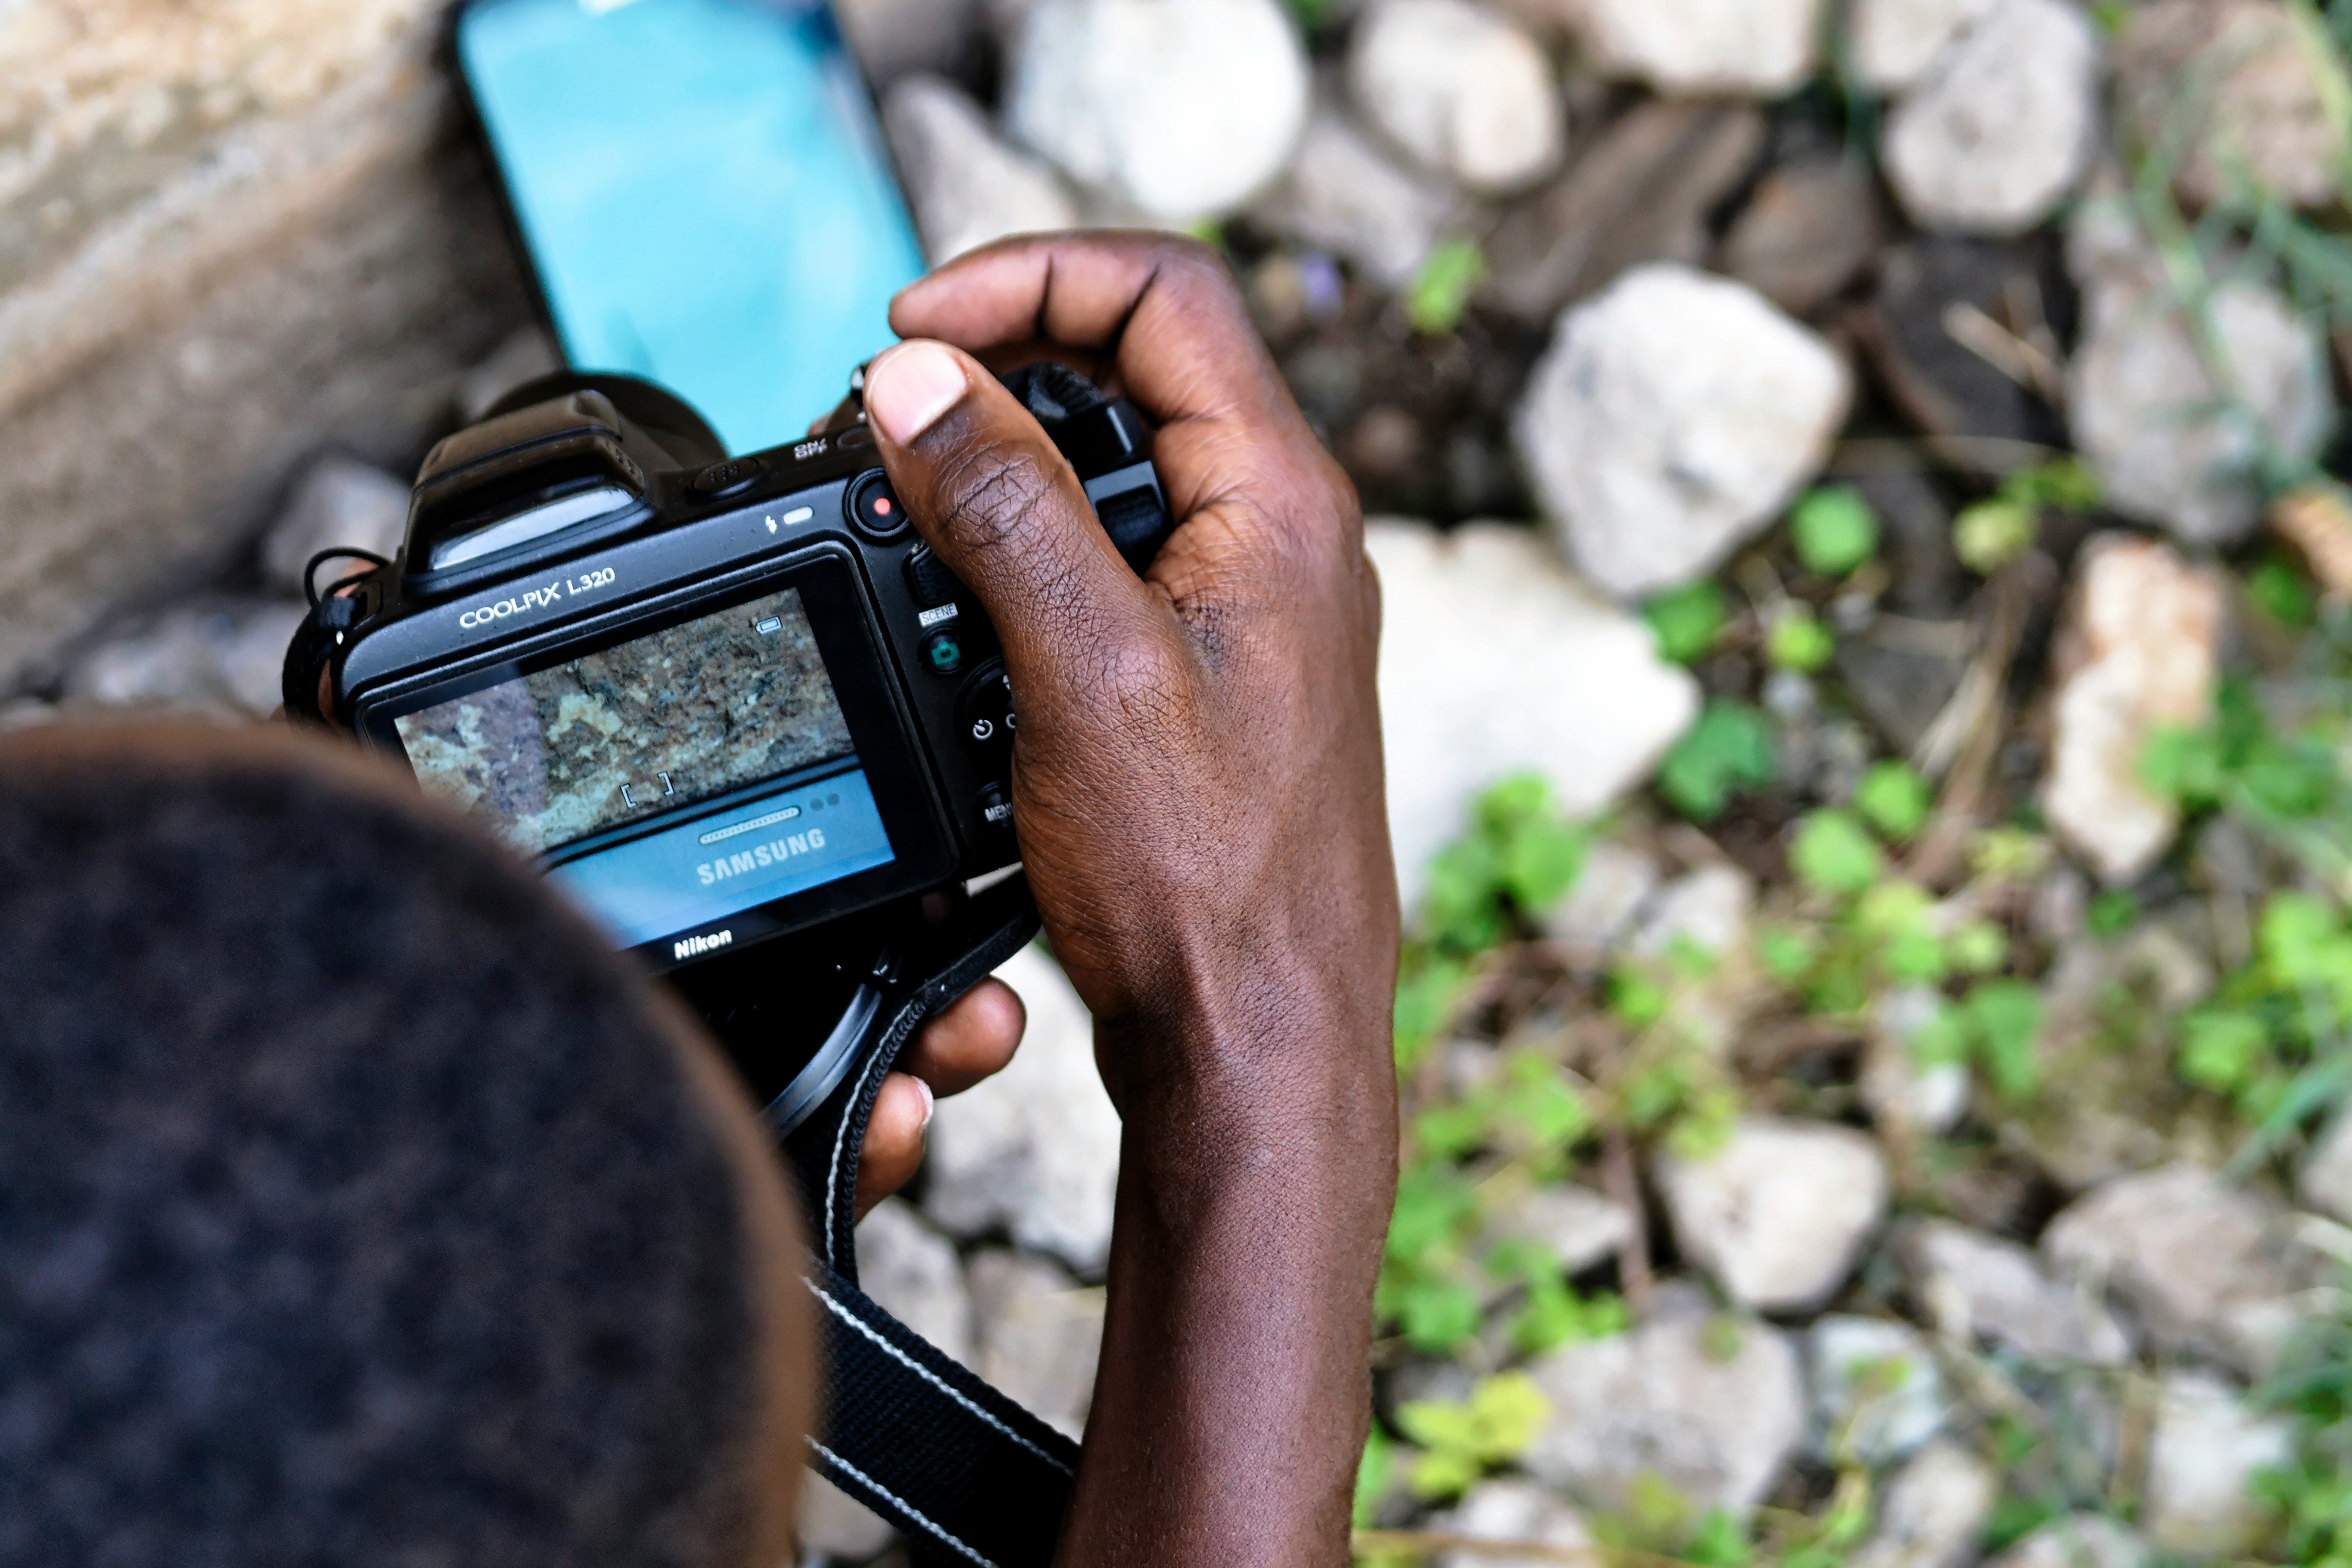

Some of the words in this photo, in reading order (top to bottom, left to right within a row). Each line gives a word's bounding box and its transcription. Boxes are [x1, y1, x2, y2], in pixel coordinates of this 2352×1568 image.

[460, 582, 561, 628] COOLPIX
[567, 567, 616, 595] L320
[921, 603, 955, 623] SCENE
[697, 828, 825, 885] SAMSUNG
[674, 929, 732, 960] Nikon
